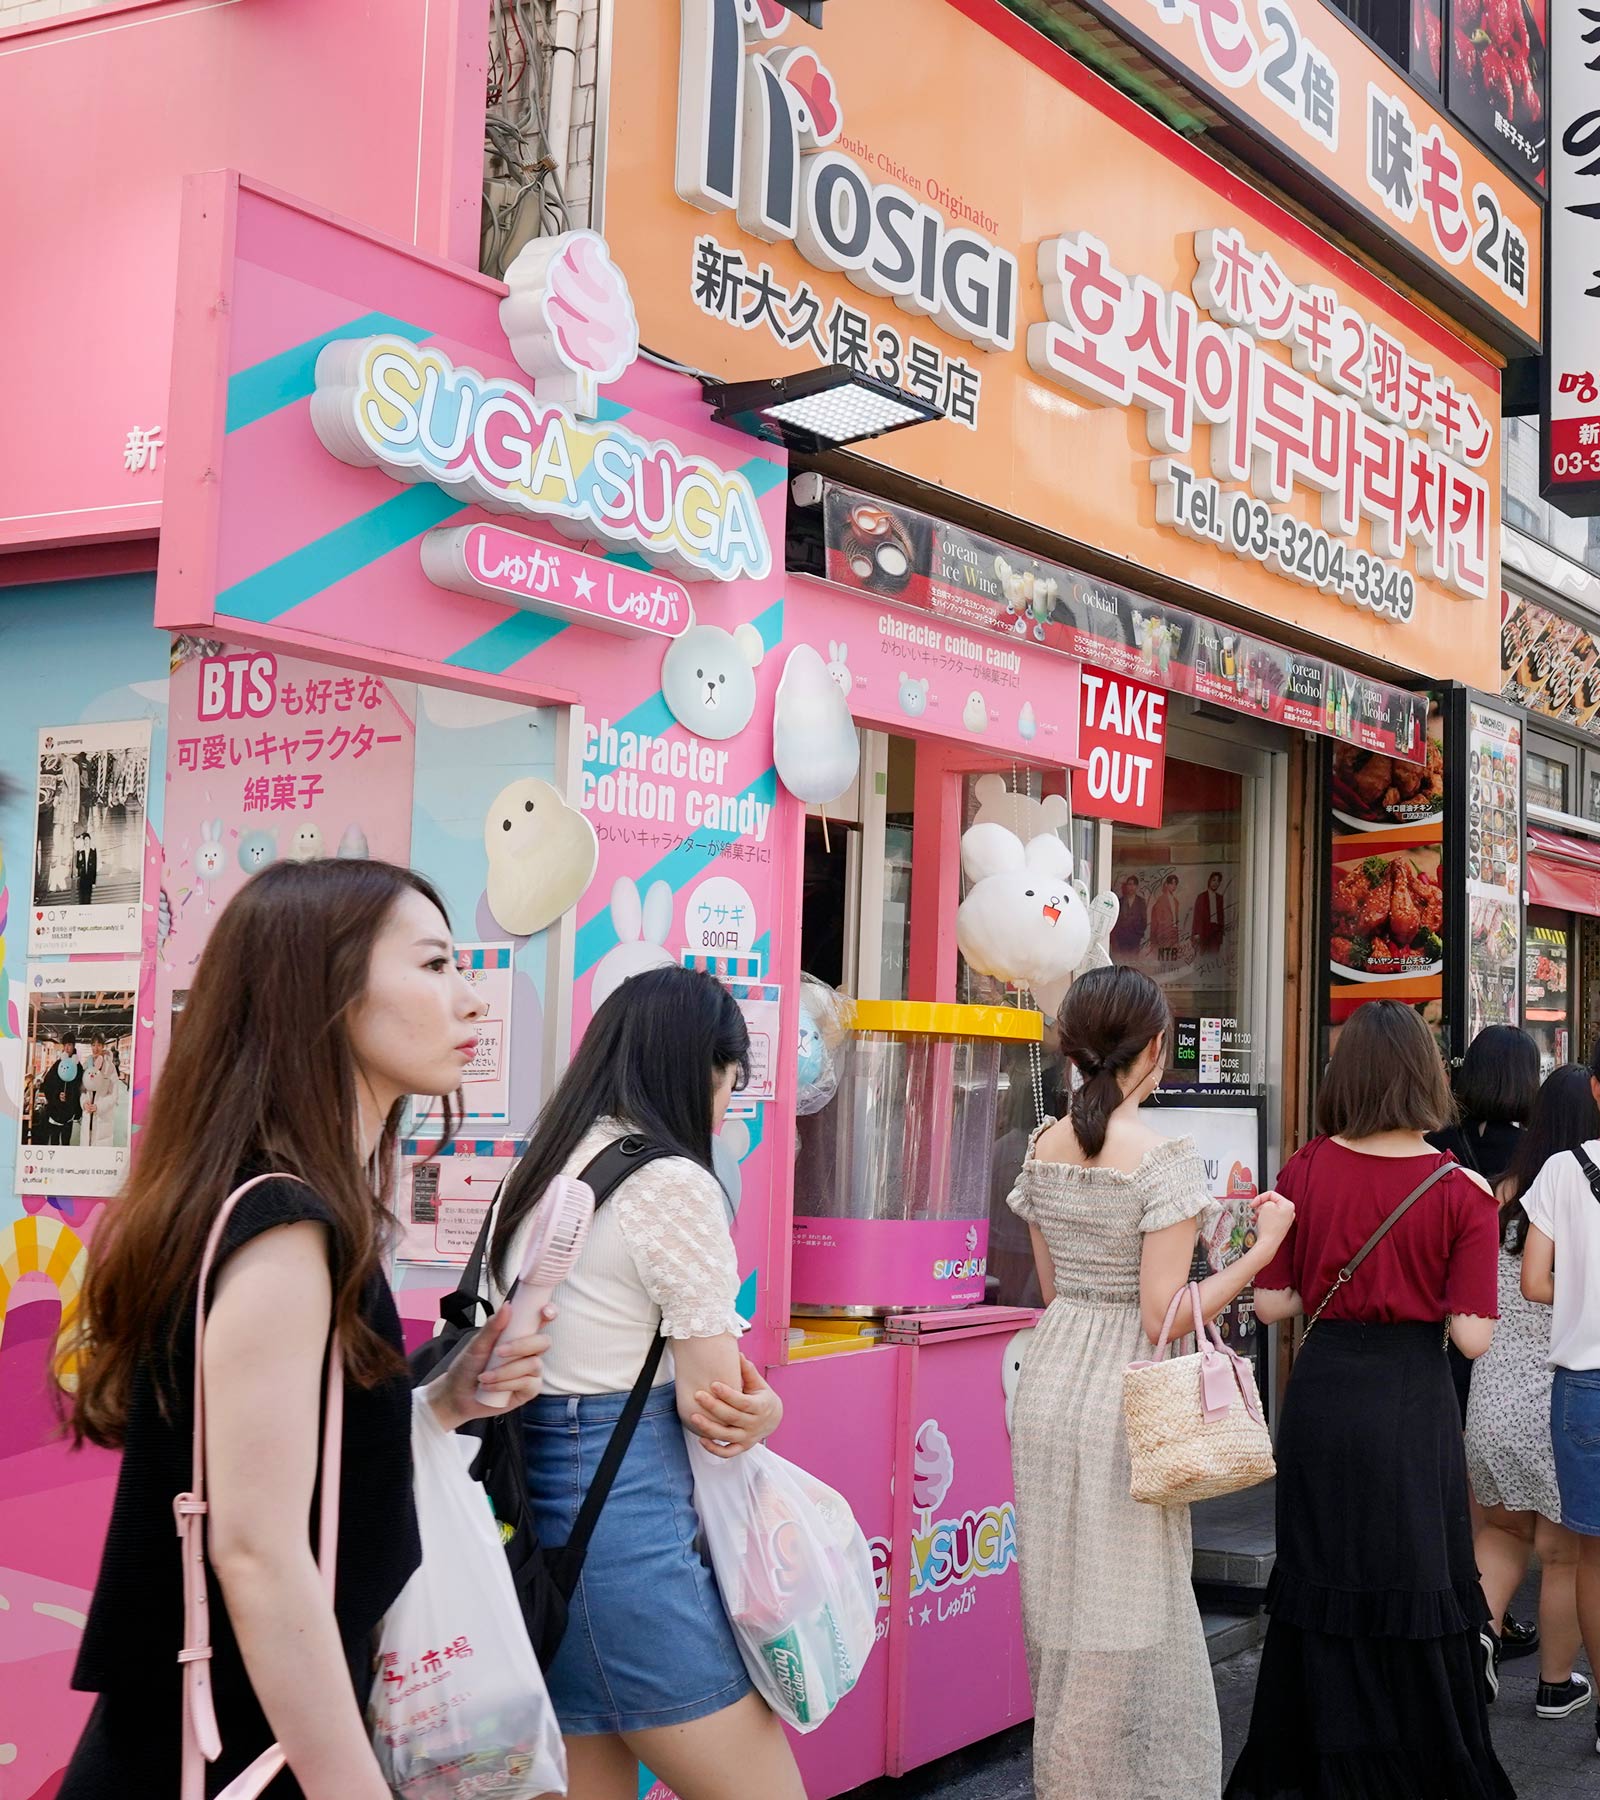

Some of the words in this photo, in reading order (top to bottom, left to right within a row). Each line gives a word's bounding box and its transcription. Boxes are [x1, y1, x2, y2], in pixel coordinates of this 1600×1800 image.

[877, 152, 922, 191] Chicken
[926, 178, 999, 237] Originator
[1371, 95, 1526, 297] 味も2倍
[695, 240, 981, 424] 新大久保3号店
[1215, 239, 1490, 461] ホシギ2羽チキン
[1052, 246, 1486, 585] 호식이두마리치킨
[363, 351, 579, 504] SUGA
[591, 429, 758, 567] SUGA
[1169, 466, 1224, 539] Tel.
[1232, 498, 1414, 622] 03-3204-3349
[474, 542, 561, 595] しゅが
[604, 570, 682, 638] しゅが
[963, 565, 998, 597] Wine
[1073, 583, 1119, 617] Cocktail
[878, 613, 943, 648] character
[944, 630, 984, 661] cotton
[985, 644, 1022, 676] candy
[202, 656, 275, 718] BTS
[279, 674, 384, 715] も好きな
[1285, 654, 1321, 681] Korean
[1285, 677, 1323, 701] Alcohol
[1081, 672, 1165, 745] TAKE
[177, 728, 402, 773] 可愛いキャラクター
[583, 718, 728, 785] character
[243, 776, 325, 814] 綿菓子
[1087, 745, 1152, 808] OUT
[580, 770, 675, 823] cotton
[685, 791, 771, 843] candy
[697, 902, 746, 927] ウサギ
[702, 930, 739, 950] 800円
[1178, 1033, 1196, 1047] Uber
[1221, 1018, 1238, 1029] OPEN
[1221, 1032, 1233, 1044] AM
[1233, 1032, 1251, 1045] 11:00
[1178, 1047, 1195, 1061] Eats
[1221, 1058, 1240, 1069] CLOSE
[1220, 1072, 1232, 1084] PM
[1231, 1072, 1250, 1084] 24:00
[933, 1258, 970, 1281] SUGA
[969, 1256, 987, 1279] SUG
[928, 1516, 1017, 1585] SUGA
[936, 1585, 976, 1622] しゅが
